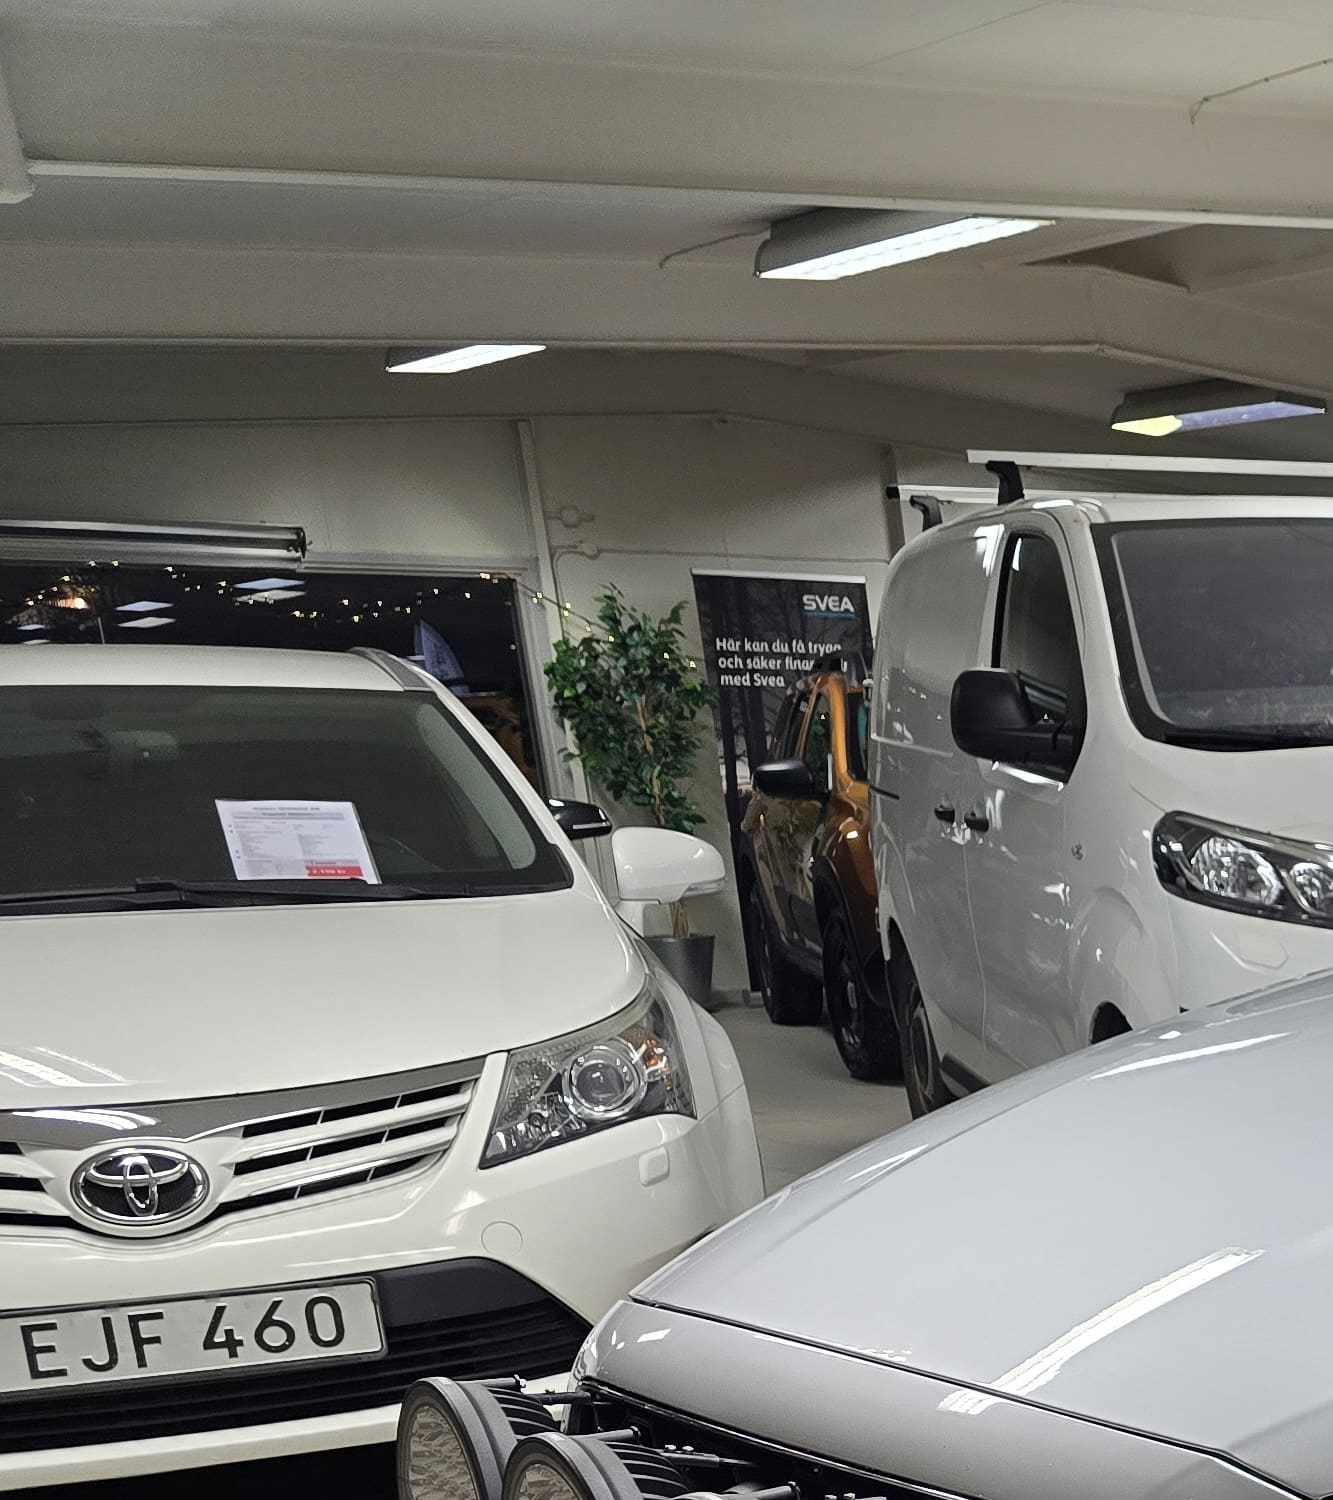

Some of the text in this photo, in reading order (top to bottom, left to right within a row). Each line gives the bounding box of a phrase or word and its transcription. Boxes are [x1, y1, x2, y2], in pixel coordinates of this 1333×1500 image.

[802, 594, 855, 612] SVEA
[716, 637, 742, 652] Här
[744, 637, 769, 652] kan
[772, 638, 790, 653] du
[792, 639, 806, 653] få
[718, 654, 743, 669] och
[746, 656, 782, 671] säker
[720, 672, 786, 688] med Svea
[20, 1295, 346, 1381] EJF 460
